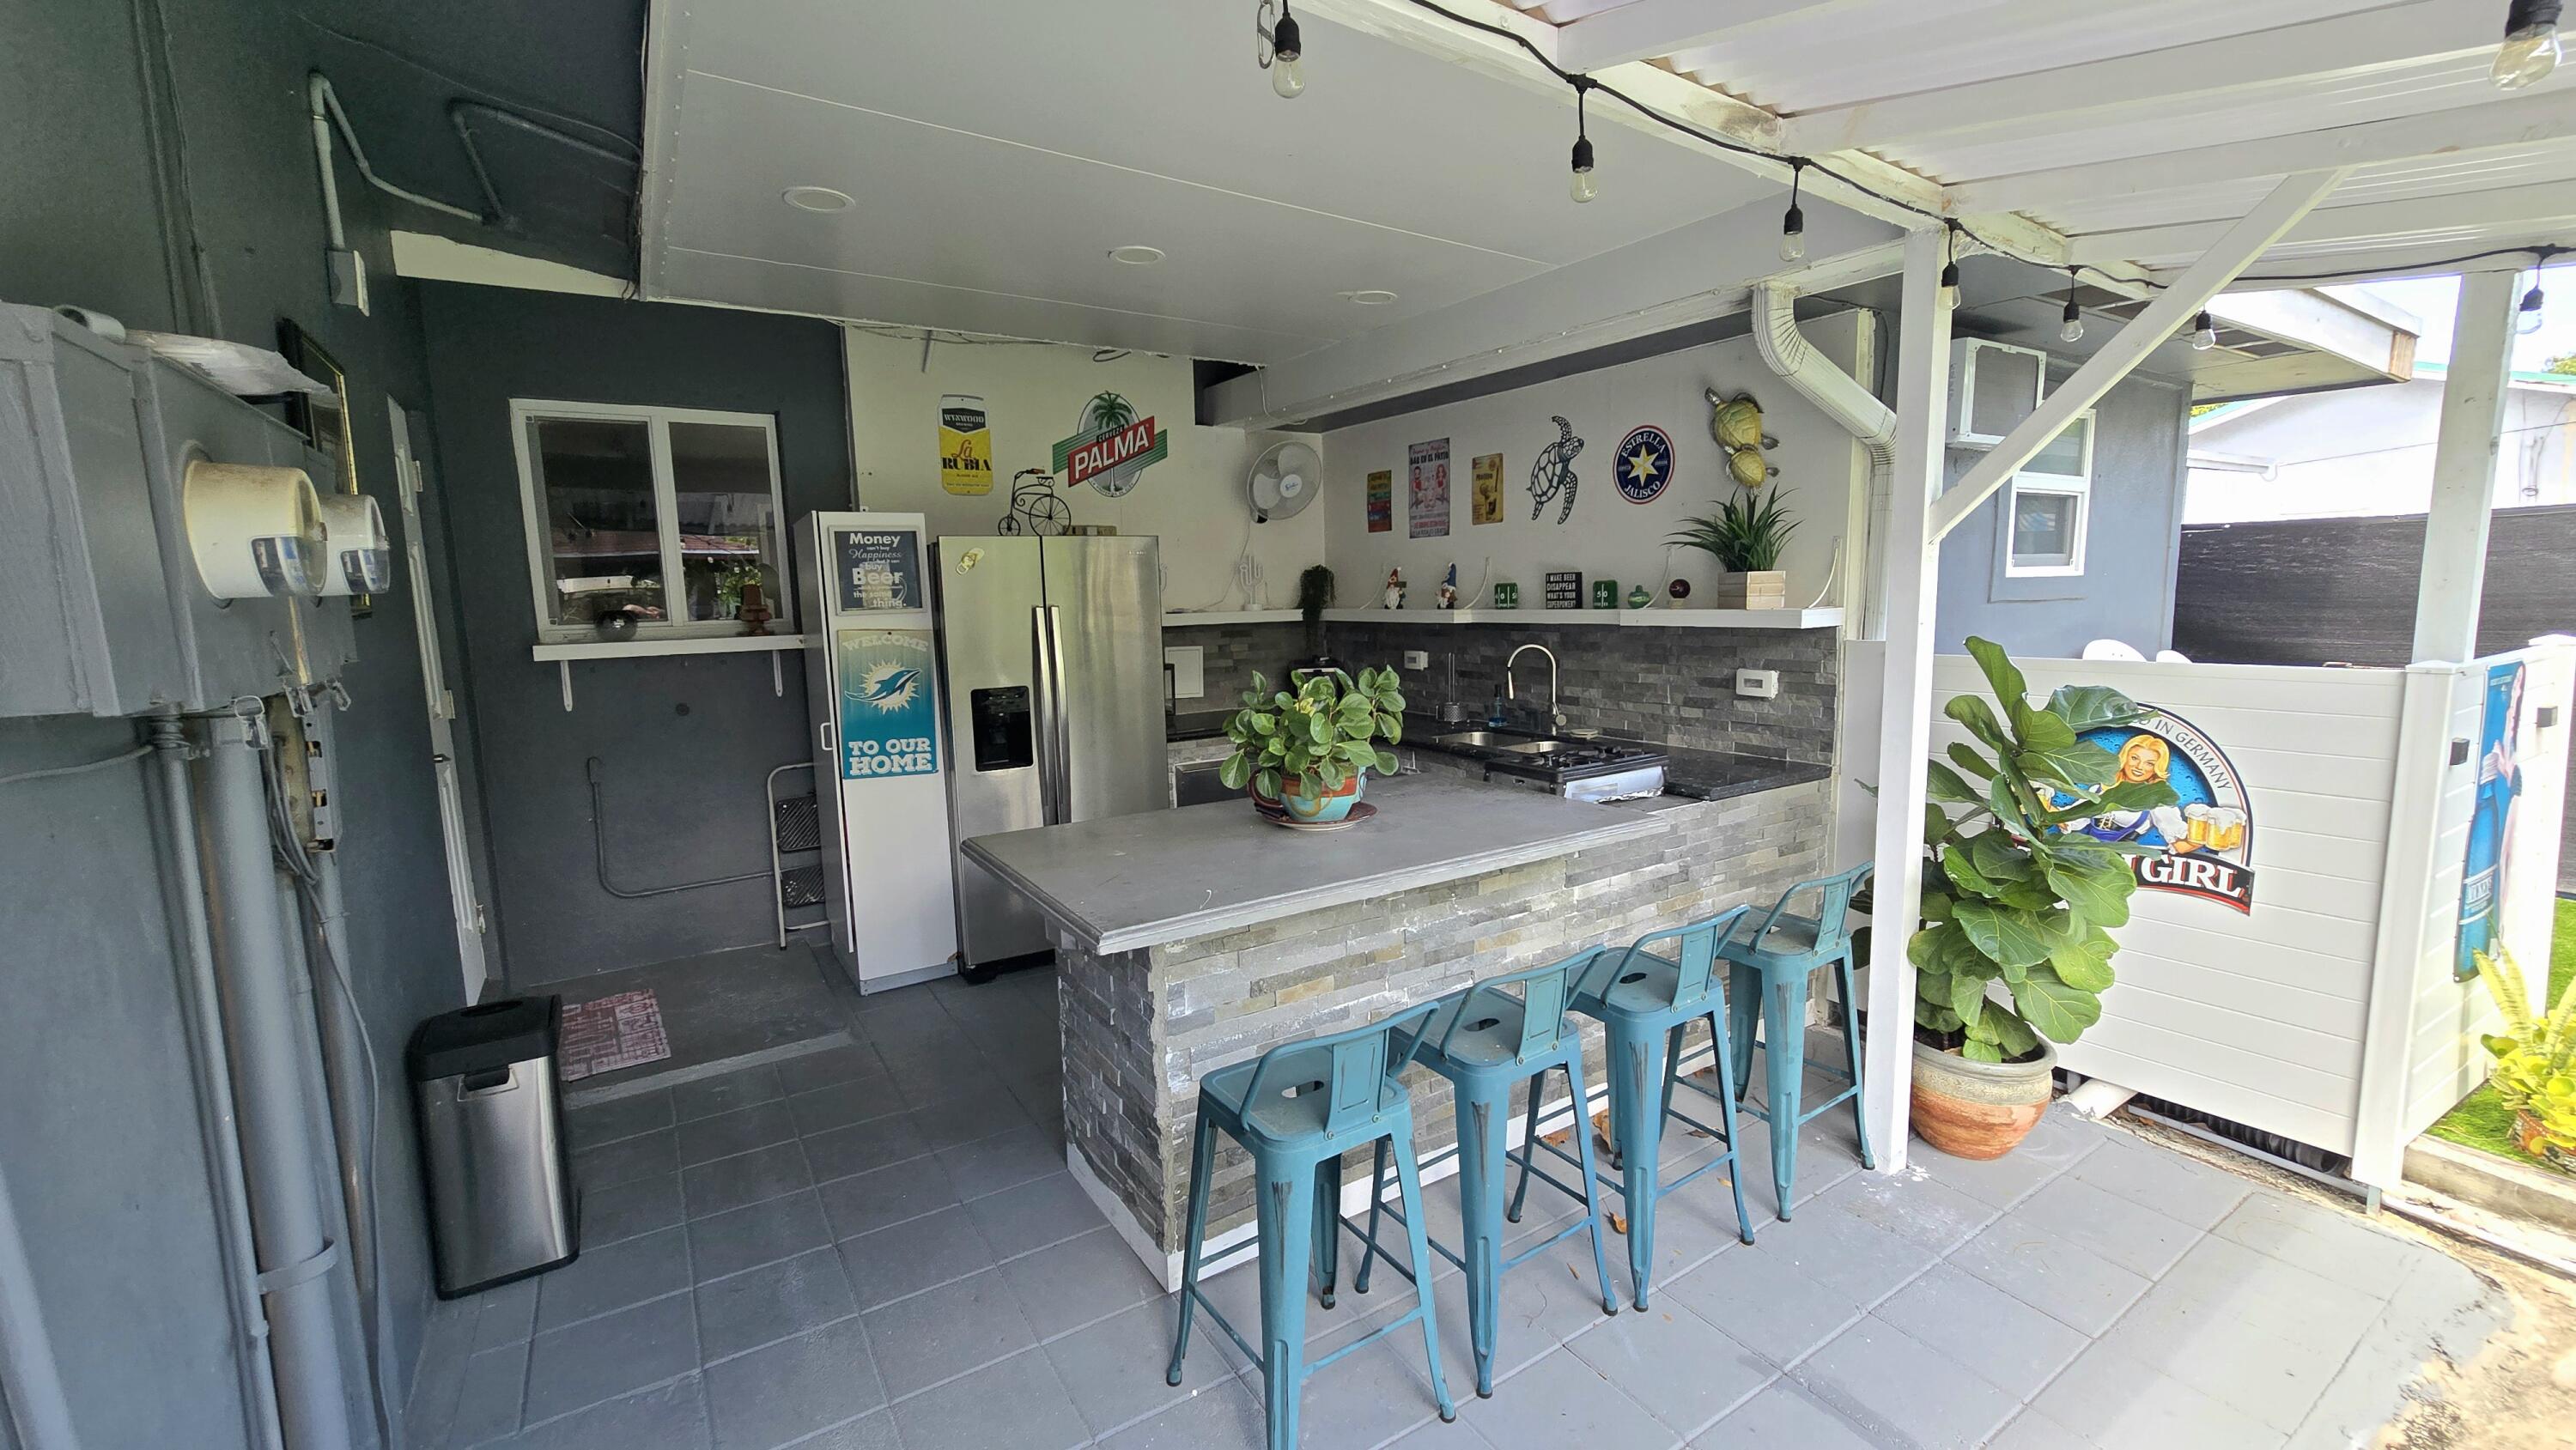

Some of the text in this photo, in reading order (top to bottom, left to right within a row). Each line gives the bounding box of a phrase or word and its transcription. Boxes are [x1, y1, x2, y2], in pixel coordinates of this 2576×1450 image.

[944, 414, 985, 423] WYNWOOD
[1098, 426, 1124, 442] CERVEZA
[951, 439, 973, 461] La
[1075, 425, 1149, 479] PALMA
[1621, 432, 1666, 458] ESTRELLA
[942, 458, 992, 470] RUBIA
[1625, 481, 1661, 498] JALISCO
[849, 533, 901, 547] Money
[848, 549, 902, 561] Happiness
[866, 561, 883, 571] buy
[853, 567, 903, 585] Beer
[1546, 582, 1576, 591] DISAPPEAR
[873, 598, 907, 609] thing.
[841, 634, 928, 652] WELCOME
[848, 737, 932, 755] TO OUR
[2154, 719, 2233, 790] IN GERMANY
[849, 753, 933, 776] HOME
[2140, 854, 2243, 899] GIRL
